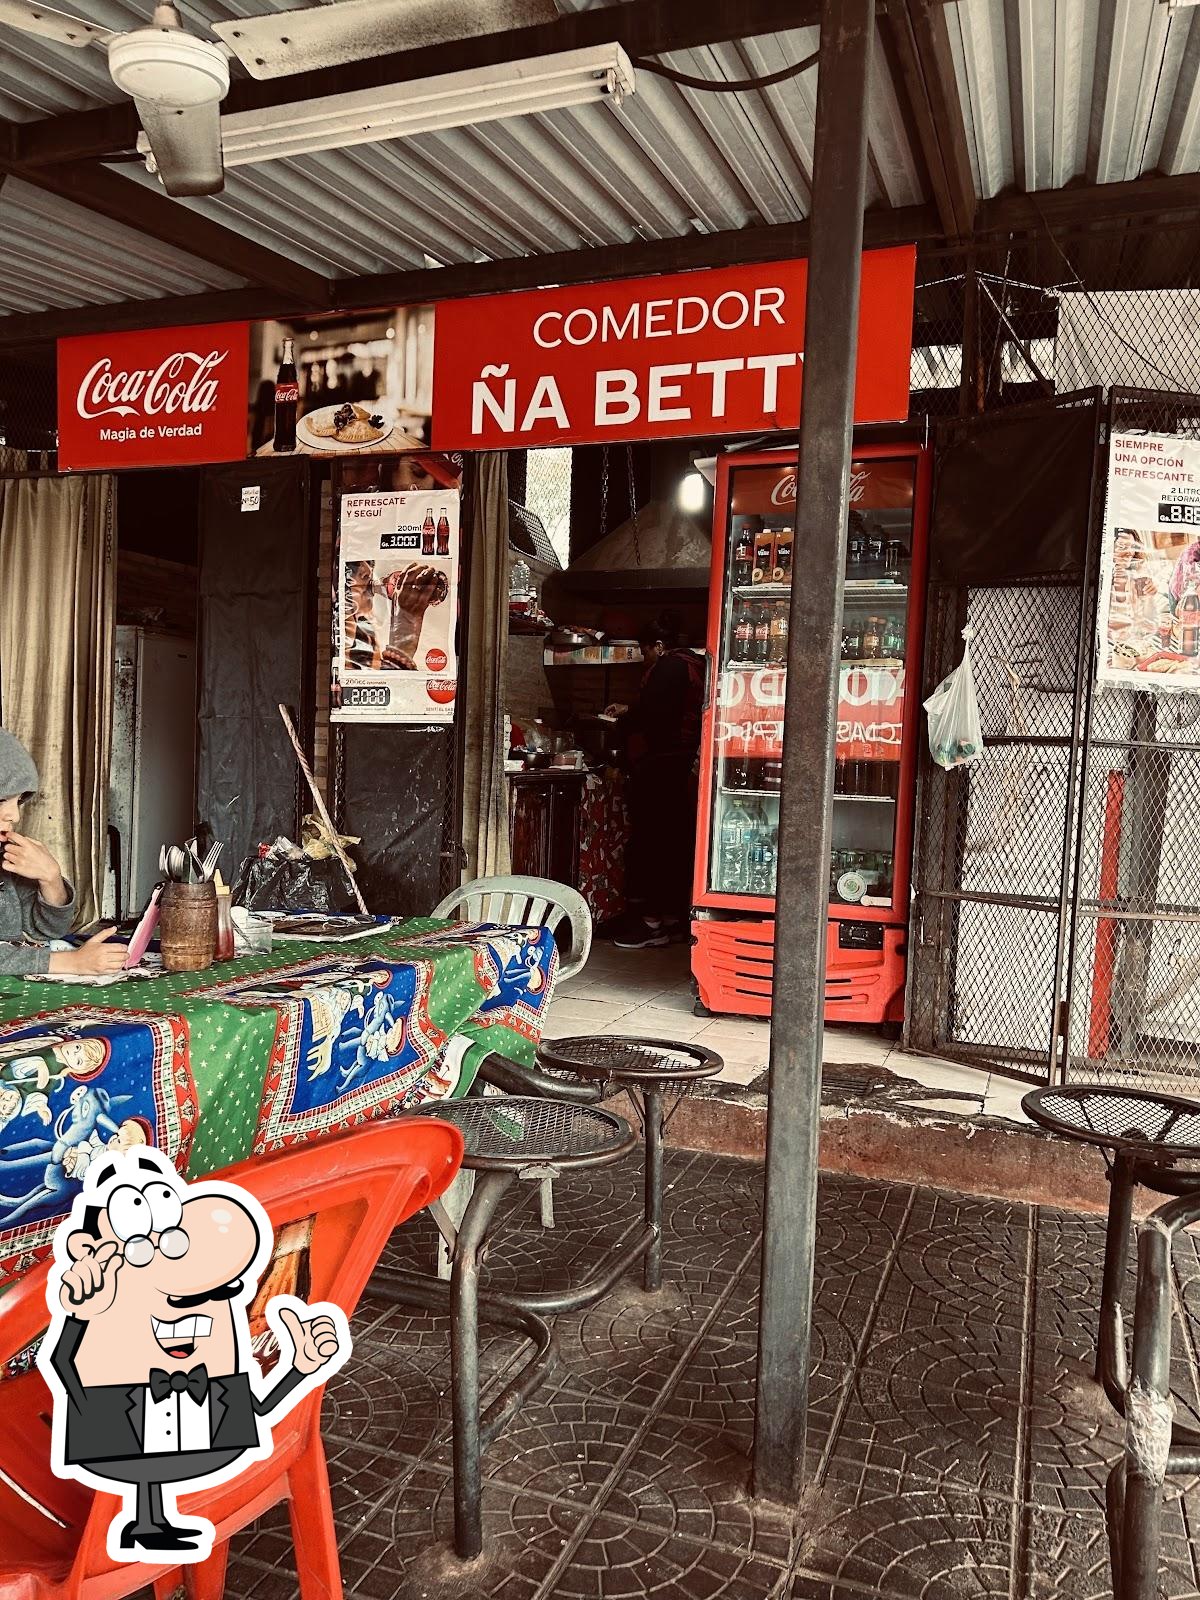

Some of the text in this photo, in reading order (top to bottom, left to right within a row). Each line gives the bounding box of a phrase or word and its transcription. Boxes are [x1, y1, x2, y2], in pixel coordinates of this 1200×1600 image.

[532, 286, 787, 349] COMEDOR
[76, 350, 230, 419] Coca-Cola
[471, 352, 805, 435] ÑA BETT
[100, 423, 202, 442] Magia de Verdad
[1115, 439, 1164, 452] SIEMPRE
[1115, 453, 1184, 467] UNA OPCIÓN
[1114, 467, 1195, 483] REFRESCANTE
[347, 497, 406, 507] REFRESCATE
[346, 508, 382, 518] Y SEGUÍ
